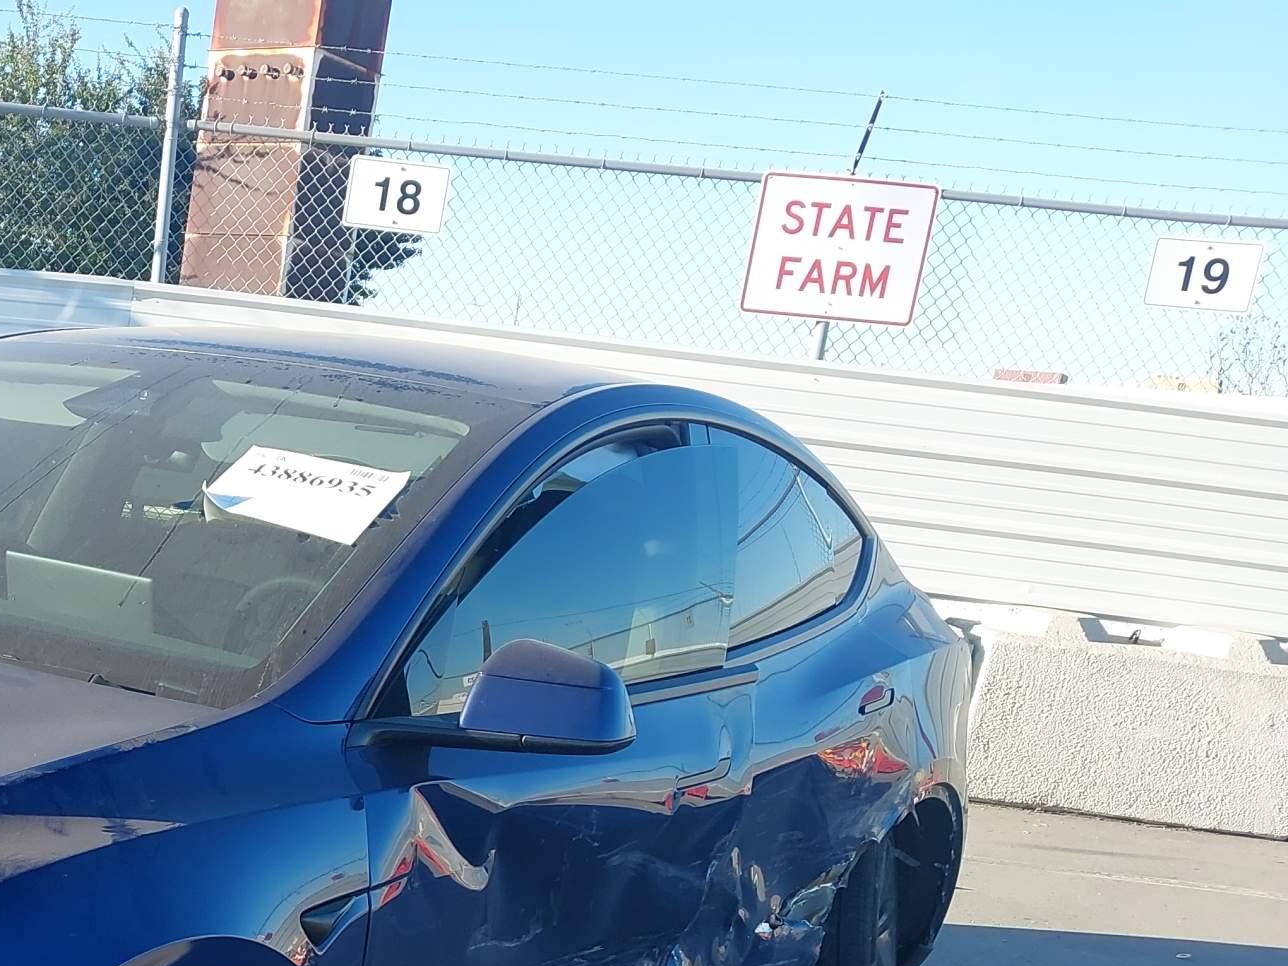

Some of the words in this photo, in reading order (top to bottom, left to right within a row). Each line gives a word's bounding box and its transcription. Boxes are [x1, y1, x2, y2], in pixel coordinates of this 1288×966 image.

[375, 176, 422, 215] 18
[781, 199, 910, 244] STATE
[775, 255, 891, 299] FARM
[1177, 255, 1230, 294] 19
[247, 463, 376, 497] 43886935
